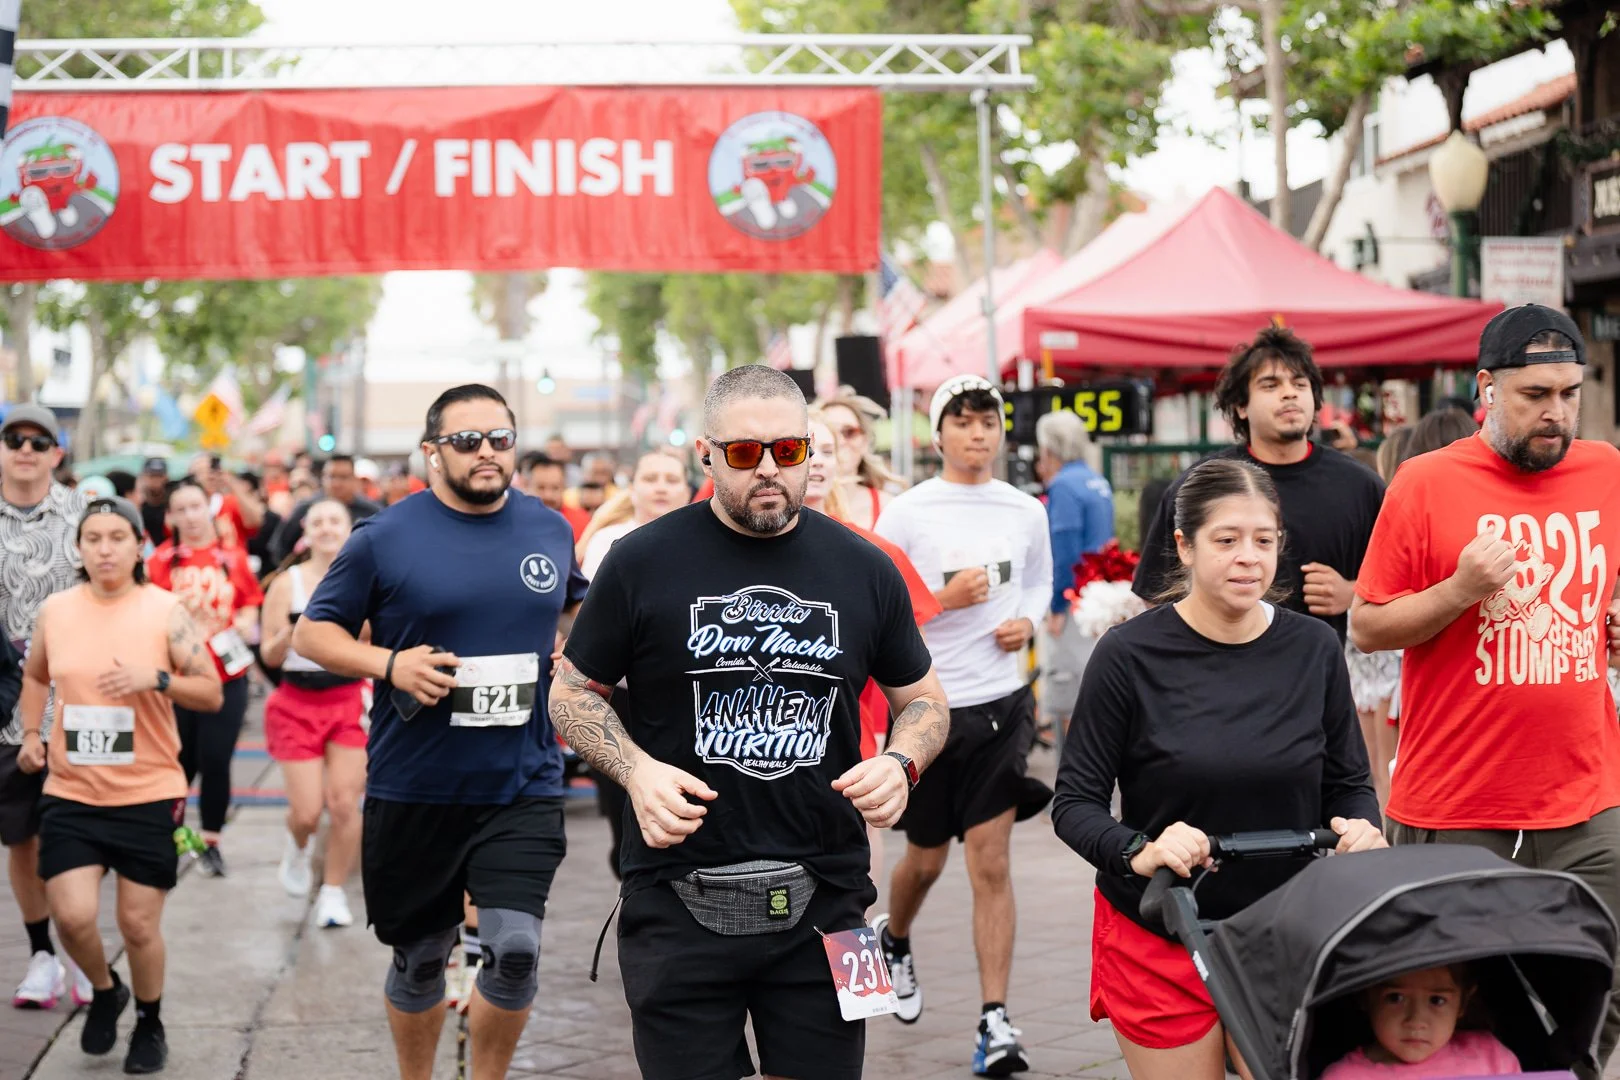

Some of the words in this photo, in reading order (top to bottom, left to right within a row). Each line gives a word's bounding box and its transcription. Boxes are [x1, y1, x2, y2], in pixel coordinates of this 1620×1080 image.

[149, 141, 371, 204] START
[385, 138, 418, 196] /
[433, 137, 674, 198] FINISH
[1476, 510, 1607, 625] 025
[721, 594, 811, 625] Birria
[687, 623, 757, 659] Don
[754, 624, 844, 661] Nacho
[1475, 619, 1570, 686] STOMP
[1575, 658, 1600, 683] 5K
[715, 657, 747, 668] Comida
[781, 658, 824, 673] Saludable
[472, 684, 520, 714] 621
[699, 684, 832, 734] ANAHEIM
[77, 730, 119, 753] 697
[696, 729, 832, 759] NUTRITION
